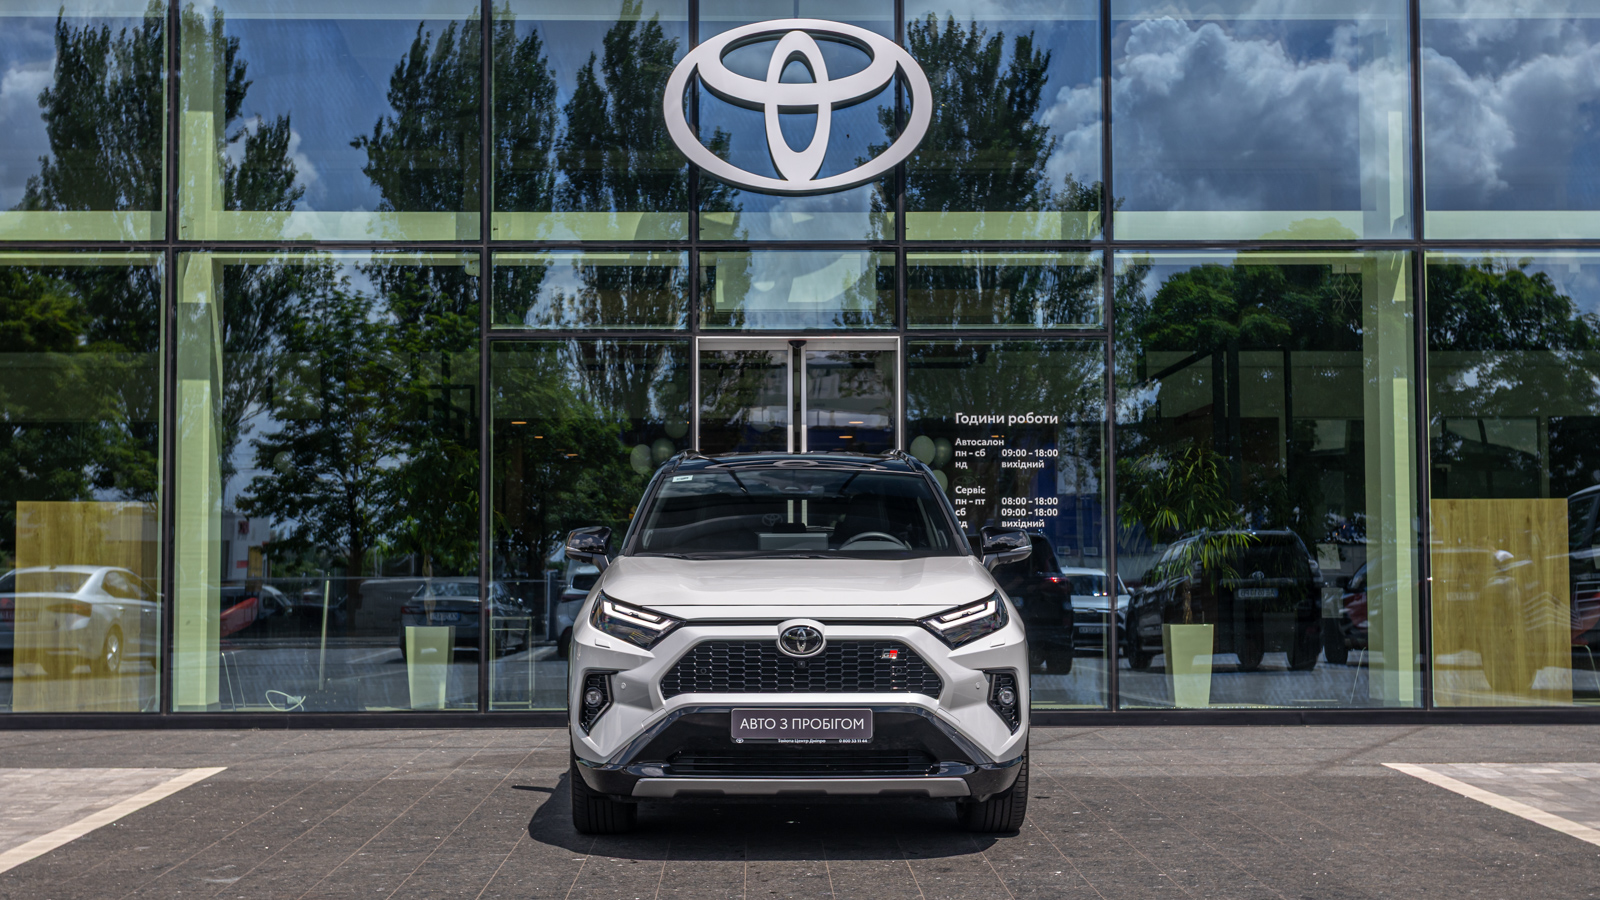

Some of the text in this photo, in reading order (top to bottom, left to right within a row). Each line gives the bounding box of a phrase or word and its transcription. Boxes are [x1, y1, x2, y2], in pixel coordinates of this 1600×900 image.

[955, 412, 1058, 426] Години роботи
[955, 438, 1005, 446] Автосалон
[955, 449, 967, 457] пн
[974, 448, 986, 457] сб
[1001, 448, 1027, 457] 09:00
[1034, 448, 1059, 457] 18:00
[955, 460, 1045, 470] нд вихідний
[955, 486, 986, 496] Сервіс
[1001, 497, 1027, 505] 08:00
[1034, 497, 1059, 505] 18:00
[955, 508, 967, 516] сб
[1001, 508, 1027, 516] 09:00
[1034, 508, 1058, 516] 18:00
[1001, 519, 1045, 529] вихідний
[739, 718, 865, 730] АВТО З ПРОБІГОМ
